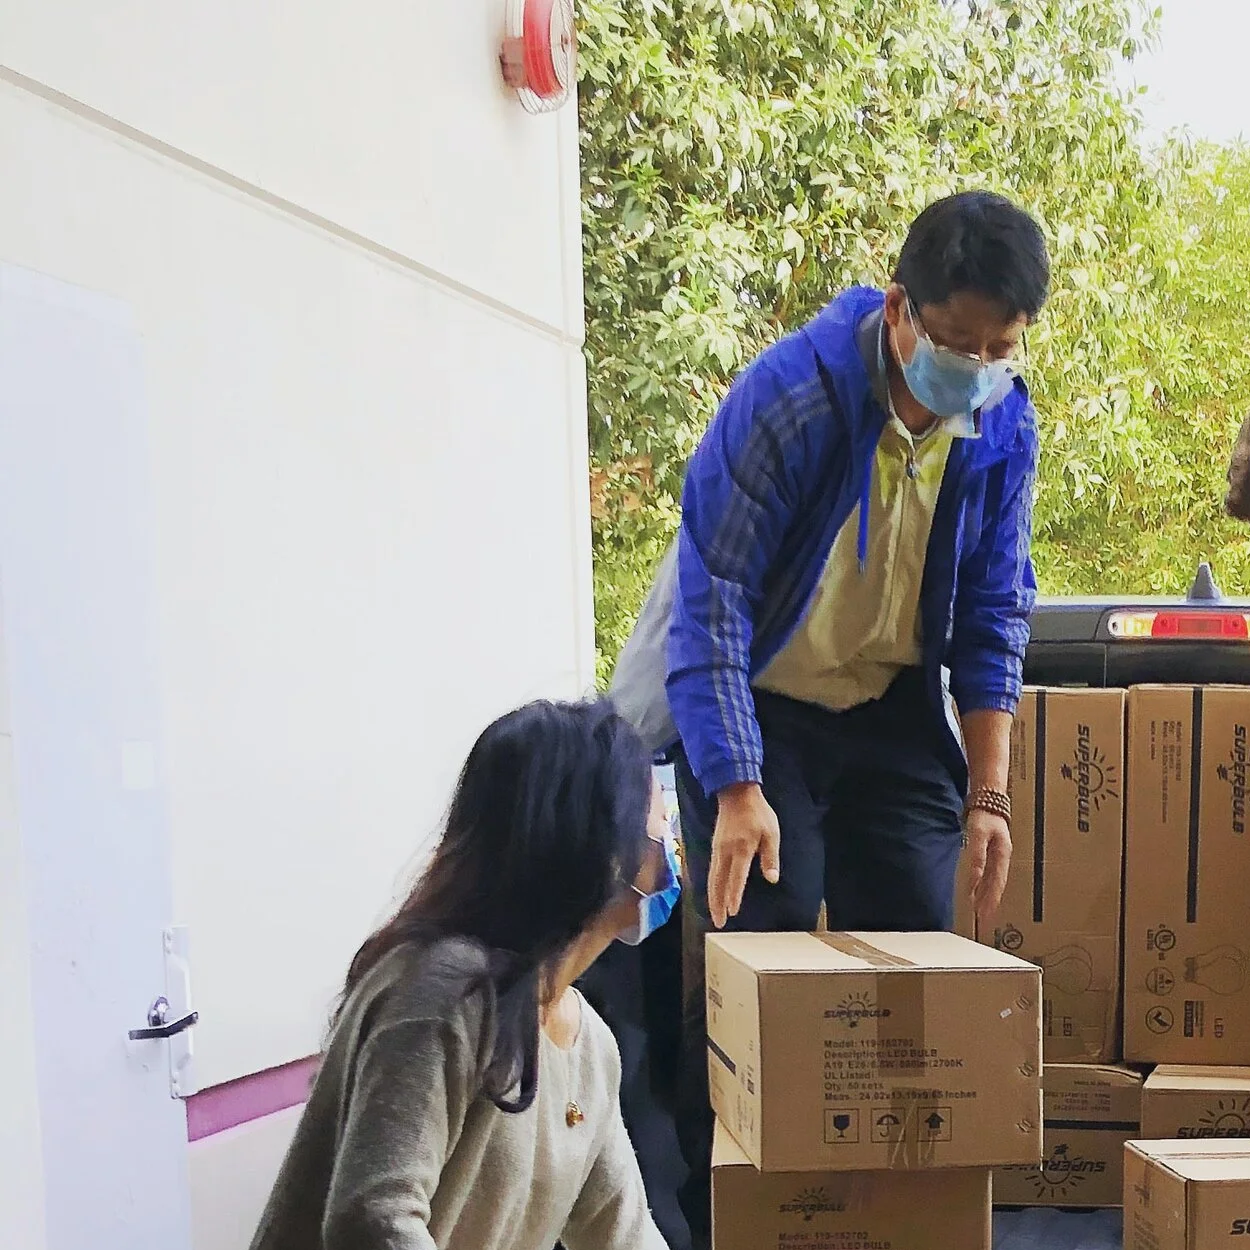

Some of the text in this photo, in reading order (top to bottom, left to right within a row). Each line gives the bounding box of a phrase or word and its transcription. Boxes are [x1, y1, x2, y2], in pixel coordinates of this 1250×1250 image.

[1077, 723, 1091, 834] SUPERBULB
[1232, 723, 1247, 834] SUPERBULB
[824, 1008, 891, 1018] SUPERBULB
[1063, 1016, 1072, 1037] LED
[1214, 1017, 1223, 1038] LED
[824, 1040, 857, 1048] Model:
[909, 1048, 938, 1058] BULB
